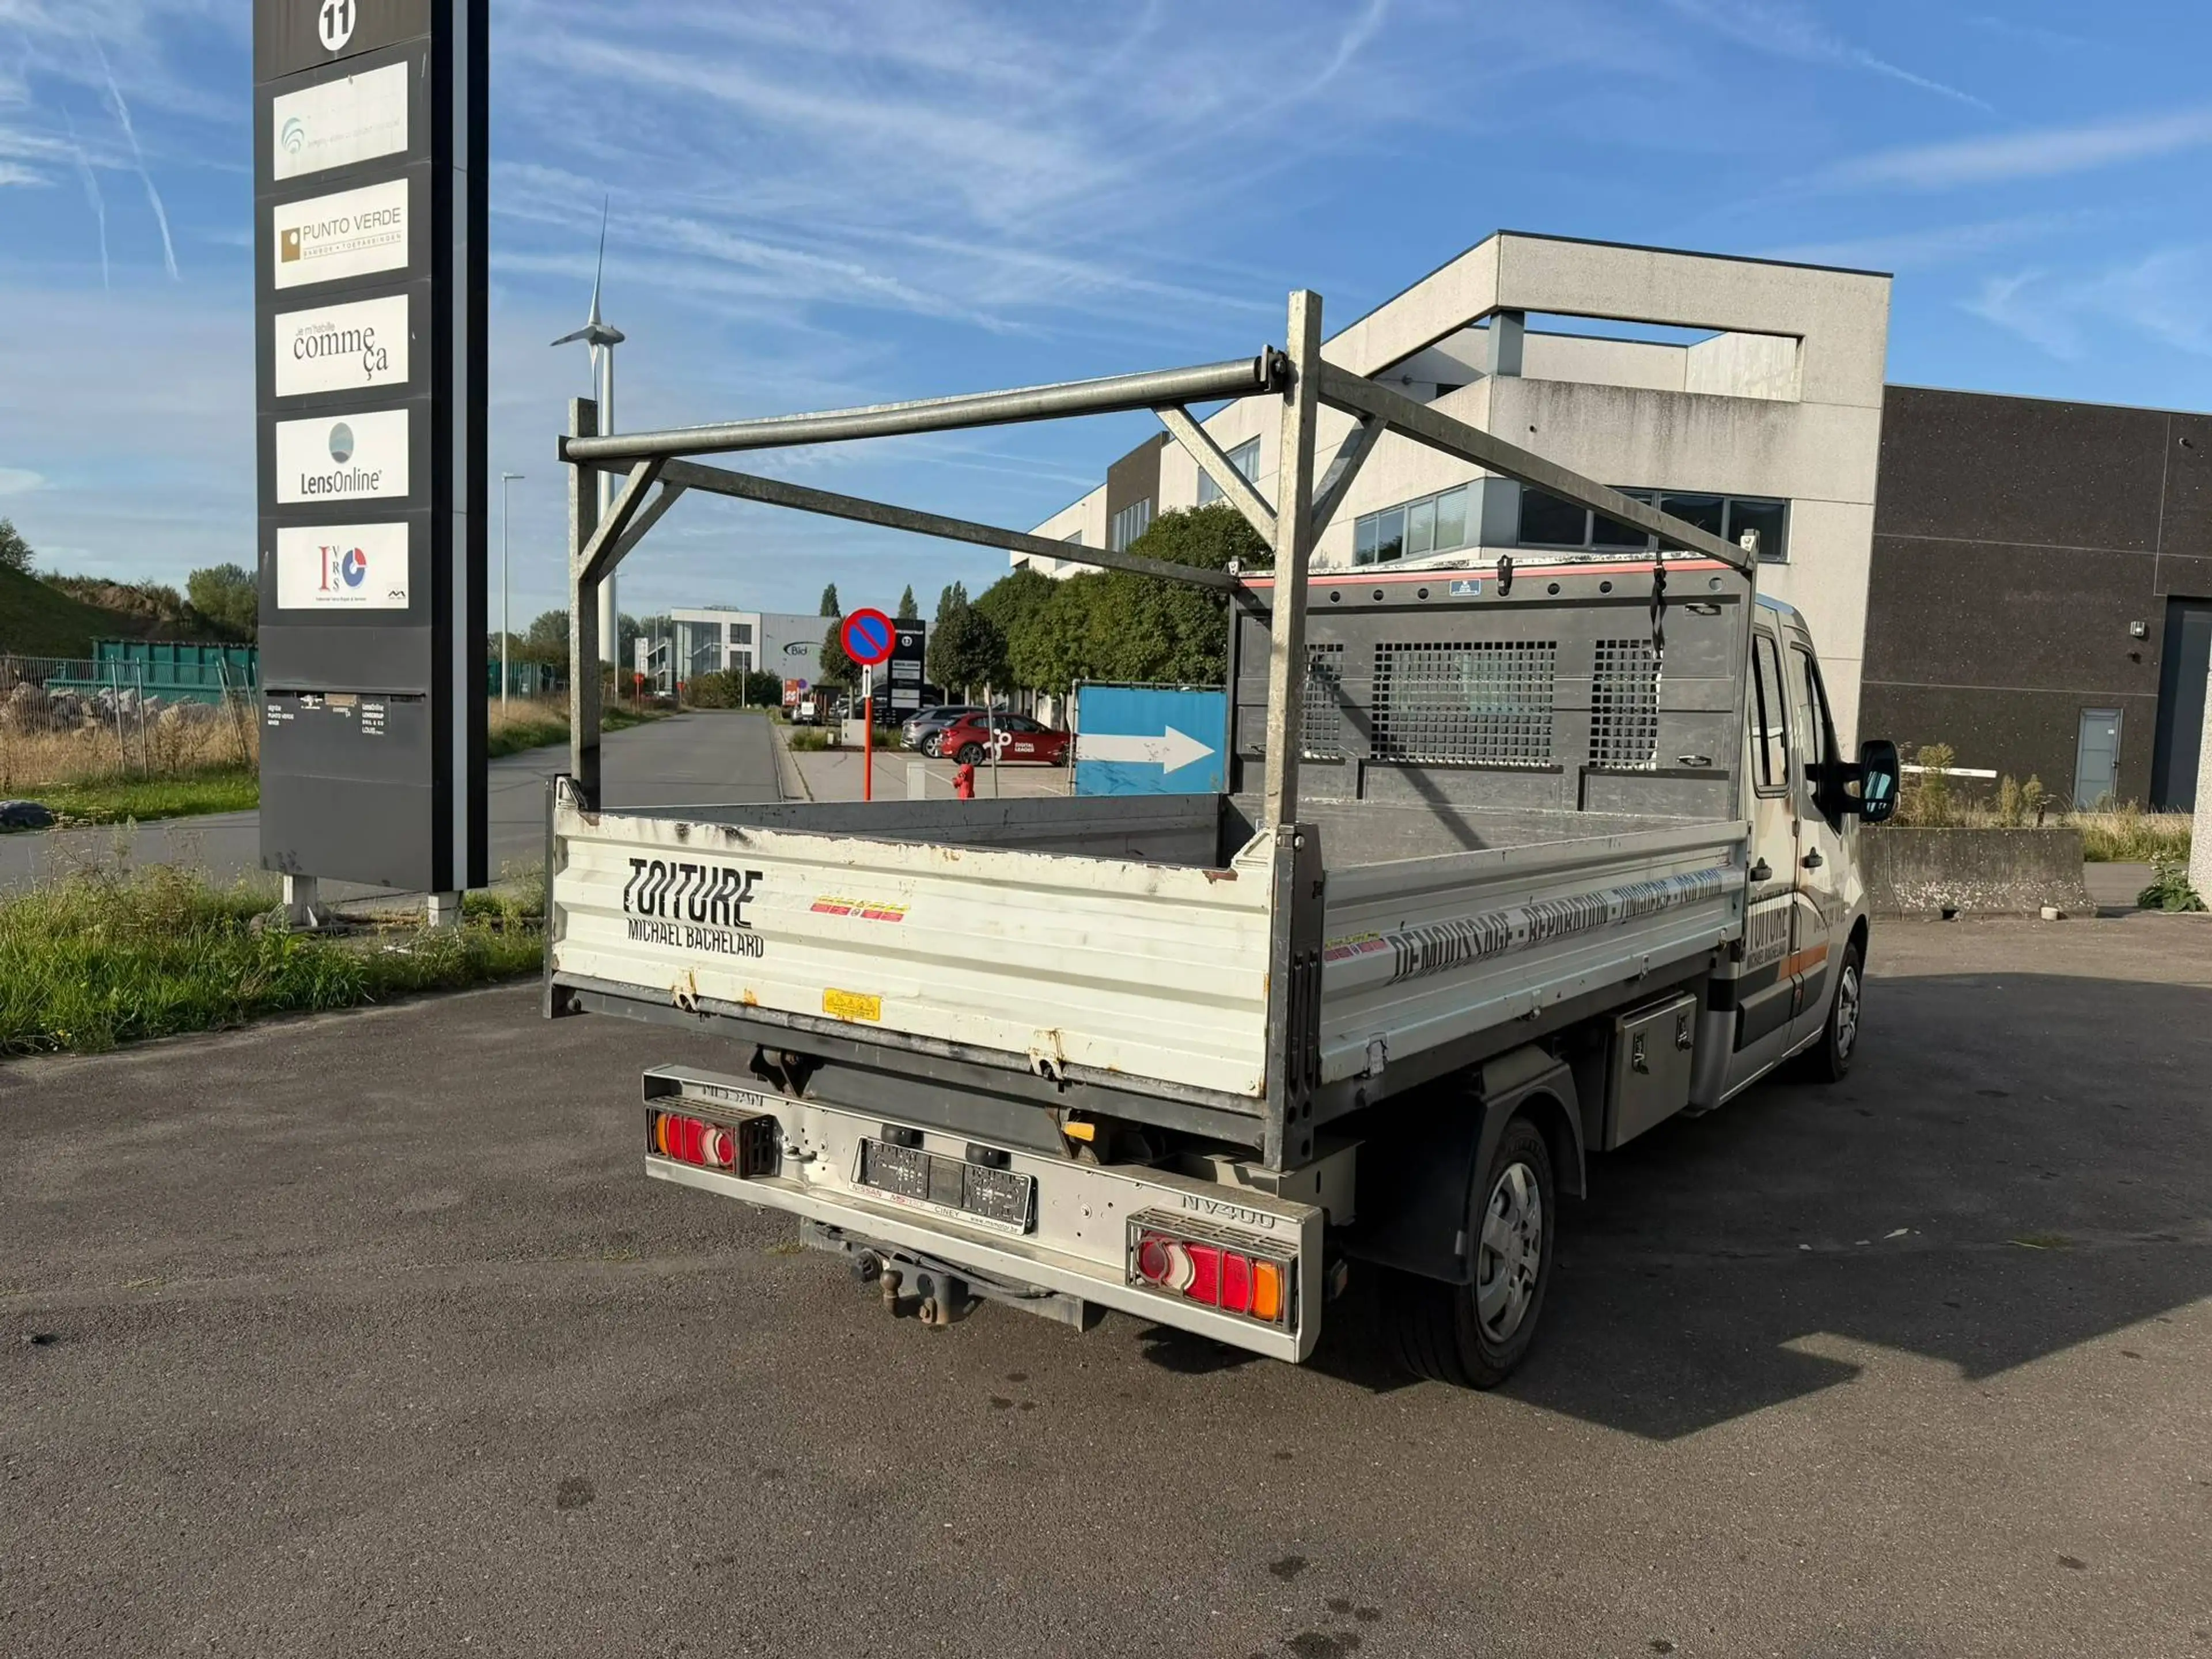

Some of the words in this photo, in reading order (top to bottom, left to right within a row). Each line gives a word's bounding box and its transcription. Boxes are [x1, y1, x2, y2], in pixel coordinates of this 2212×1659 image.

[323, 1, 349, 39] 11
[303, 218, 350, 241] PUNTO
[354, 207, 402, 229] VERDE
[294, 327, 376, 360] comme
[363, 346, 389, 381] ça
[624, 857, 763, 929] TOITURE
[628, 918, 682, 947] MICHAEL
[685, 926, 764, 959] BACHELARD
[703, 1084, 764, 1107] NISSAN
[934, 1206, 960, 1218] CINEY
[1181, 1194, 1276, 1229] NV400
